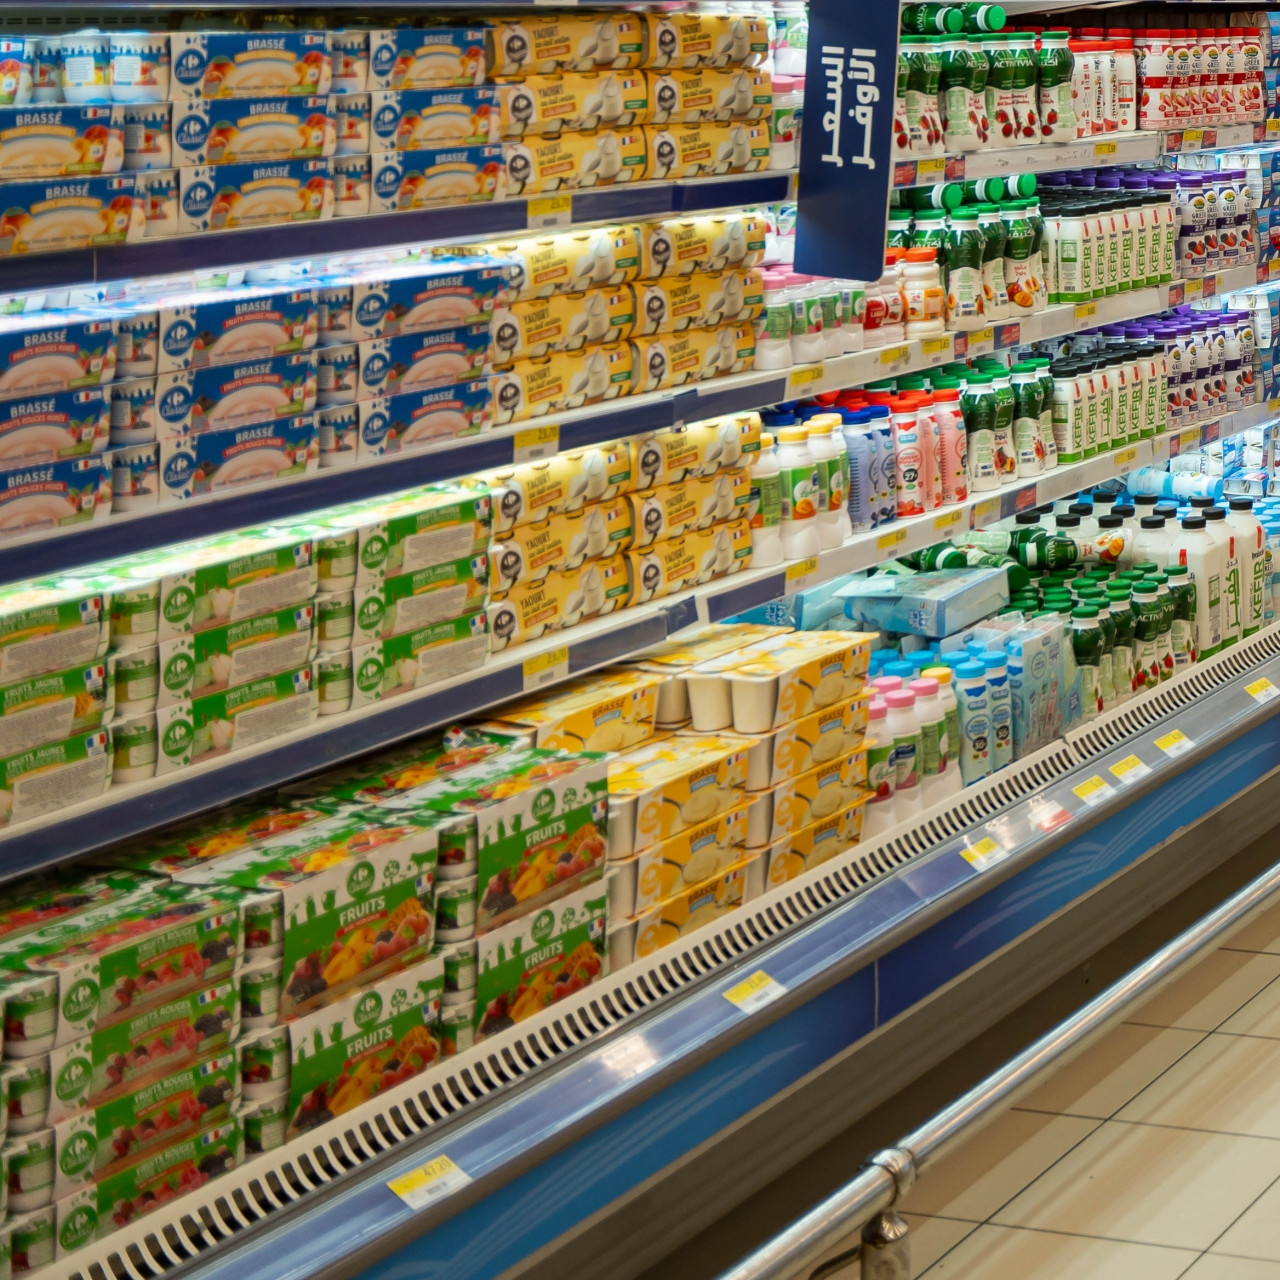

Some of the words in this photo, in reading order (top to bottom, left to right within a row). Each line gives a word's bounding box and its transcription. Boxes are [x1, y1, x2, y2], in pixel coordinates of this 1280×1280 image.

[821, 45, 845, 167] السعر
[851, 48, 877, 171] الأوفر
[1152, 231, 1160, 272] KEFIR
[524, 820, 566, 847] FRUITS
[338, 894, 386, 925] FRUITS
[524, 941, 564, 968] FRUITS
[346, 1024, 393, 1054] FRUITS
